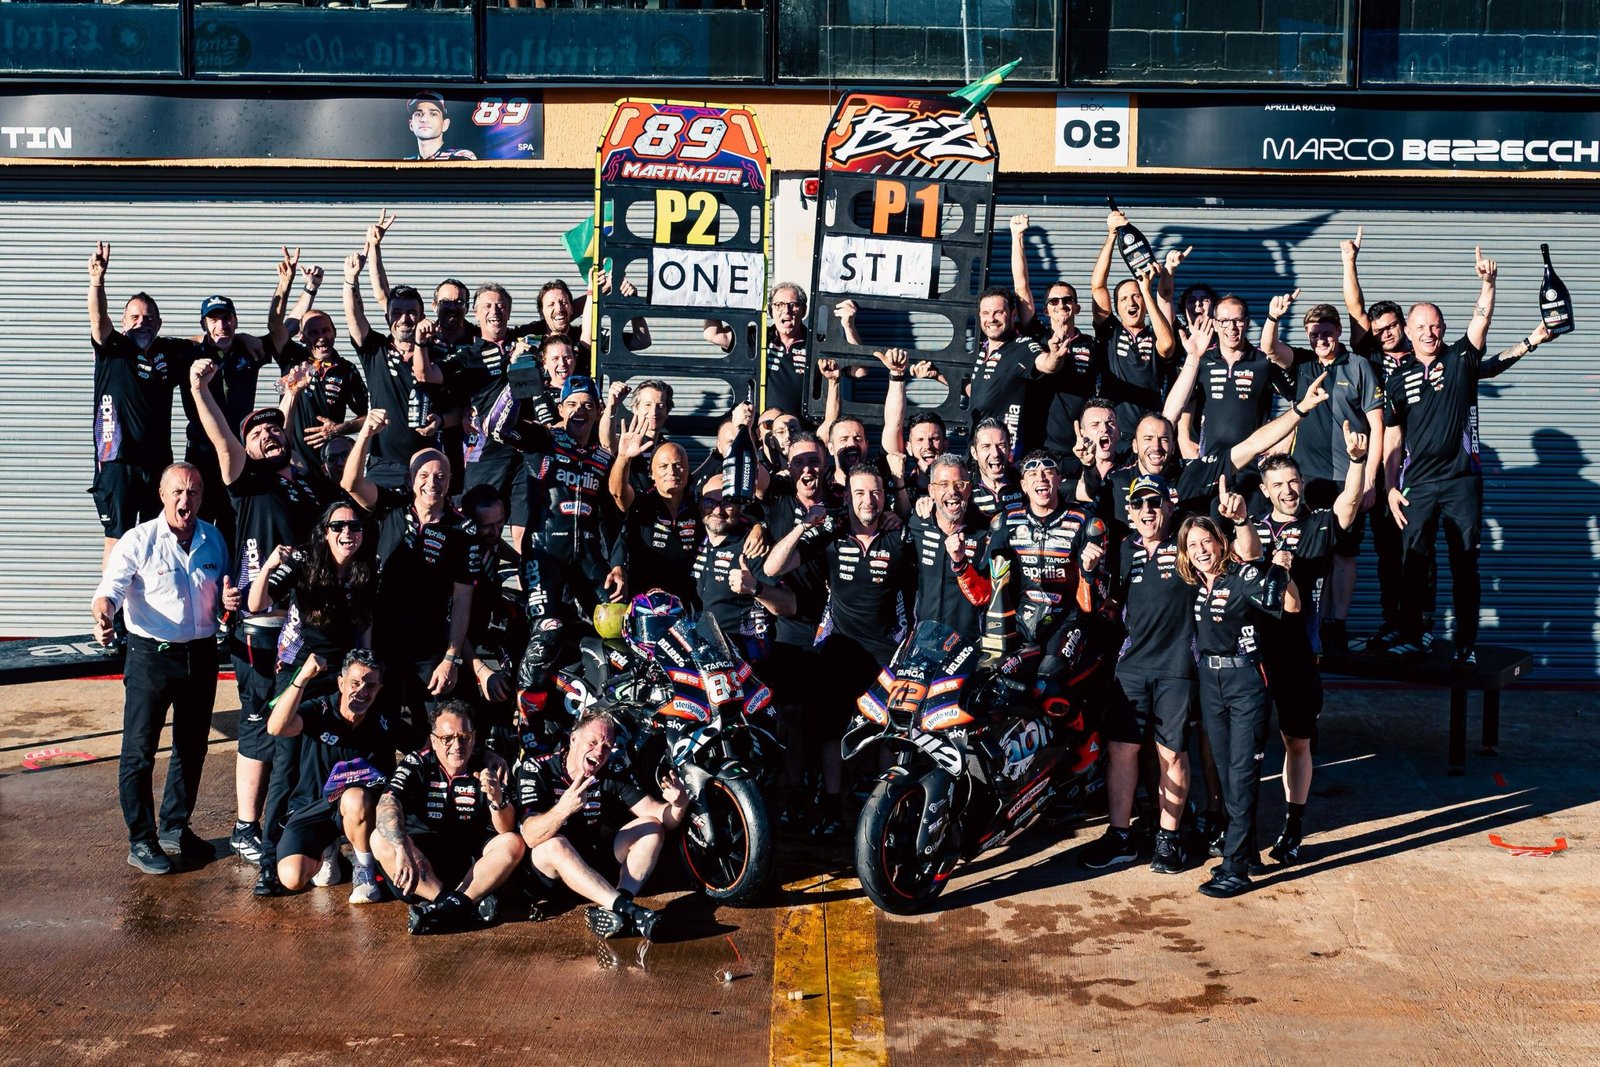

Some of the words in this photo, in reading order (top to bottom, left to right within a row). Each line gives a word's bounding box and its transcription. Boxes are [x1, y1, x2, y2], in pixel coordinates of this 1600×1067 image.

[473, 97, 530, 126] 89
[907, 99, 922, 109] 72
[1080, 103, 1105, 111] BOX
[1264, 103, 1301, 111] APRILIA
[1302, 103, 1336, 111] RACING
[2, 127, 72, 149] TIN
[633, 113, 729, 160] 89
[833, 108, 992, 161] BEZ
[1063, 119, 1120, 149] 08
[517, 143, 534, 151] SPA
[1263, 137, 1394, 161] MARCO
[622, 162, 741, 182] MARTINATOR
[655, 189, 719, 245] P2
[873, 179, 940, 239] P1
[658, 261, 749, 295] ONE
[101, 394, 115, 443] aprilia
[1469, 405, 1480, 454] aprilia
[556, 468, 600, 491] aprilia
[425, 528, 446, 540] aprilia
[1046, 556, 1071, 564] TARGA
[1022, 564, 1067, 580] aprilia
[526, 560, 548, 617] aprilia
[1061, 628, 1082, 658] aprilia
[667, 719, 686, 732] sky
[948, 728, 967, 740] sky
[320, 731, 339, 746] 89
